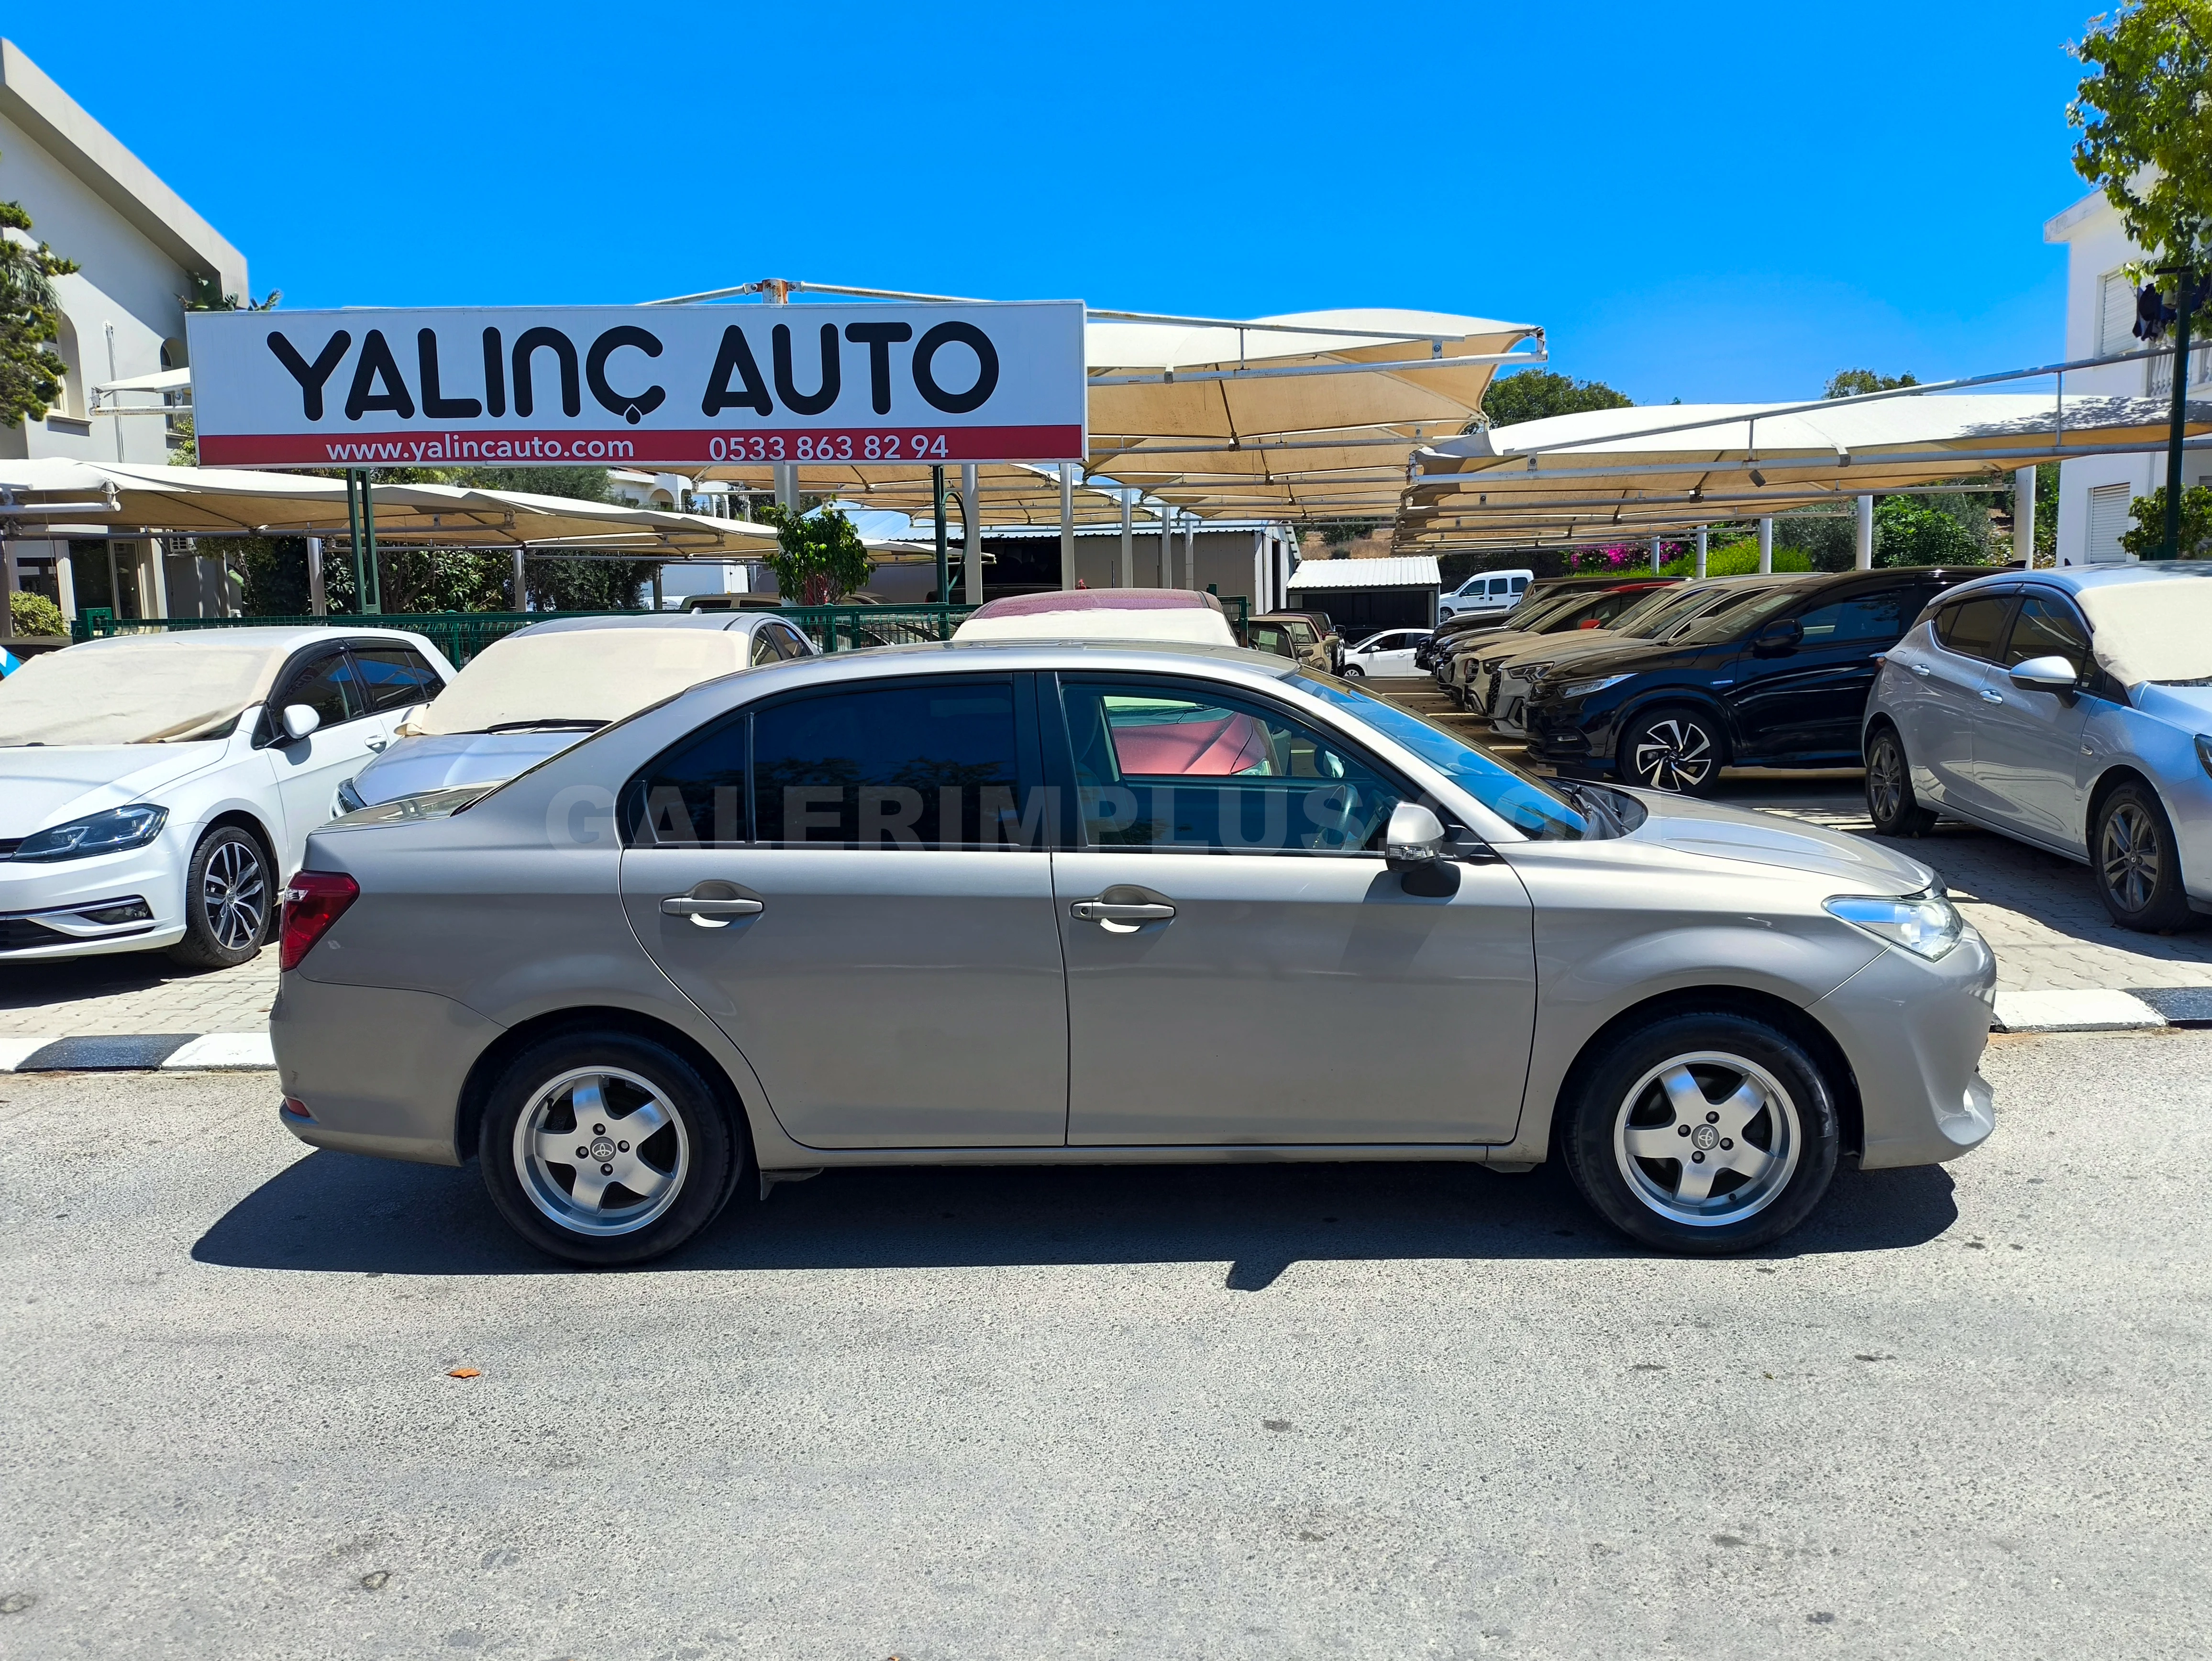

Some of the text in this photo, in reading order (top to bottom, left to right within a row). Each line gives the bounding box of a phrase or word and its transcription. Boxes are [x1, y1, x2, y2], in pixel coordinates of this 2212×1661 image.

[266, 321, 1000, 425] YALINÇ AUTO
[325, 433, 634, 463] www.yalincauto.com
[709, 434, 949, 461] 0533 863 82 94
